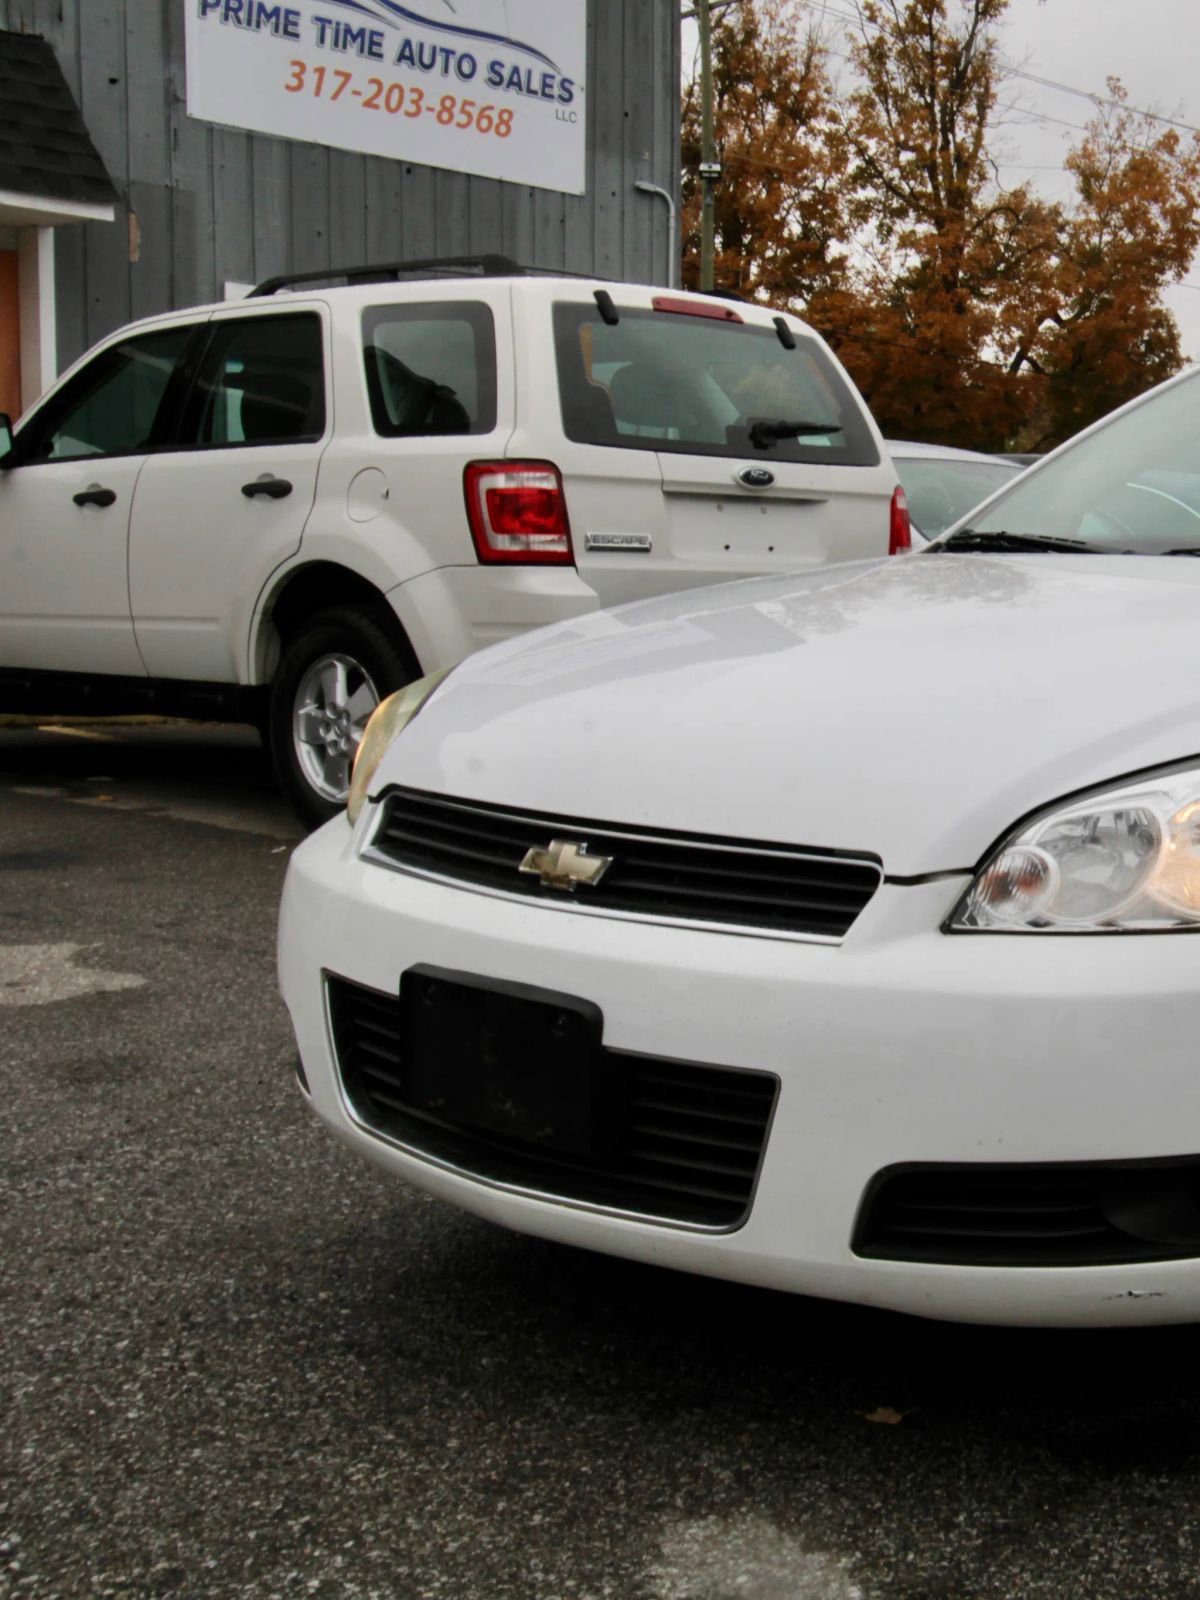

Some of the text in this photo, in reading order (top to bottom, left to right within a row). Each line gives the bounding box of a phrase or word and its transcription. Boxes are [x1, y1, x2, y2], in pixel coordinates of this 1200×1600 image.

[198, 0, 575, 106] PRIME TIME AUTO SALES
[284, 60, 514, 138] 317-203-8568
[555, 108, 577, 124] LLC
[591, 534, 649, 545] ESCAPE
